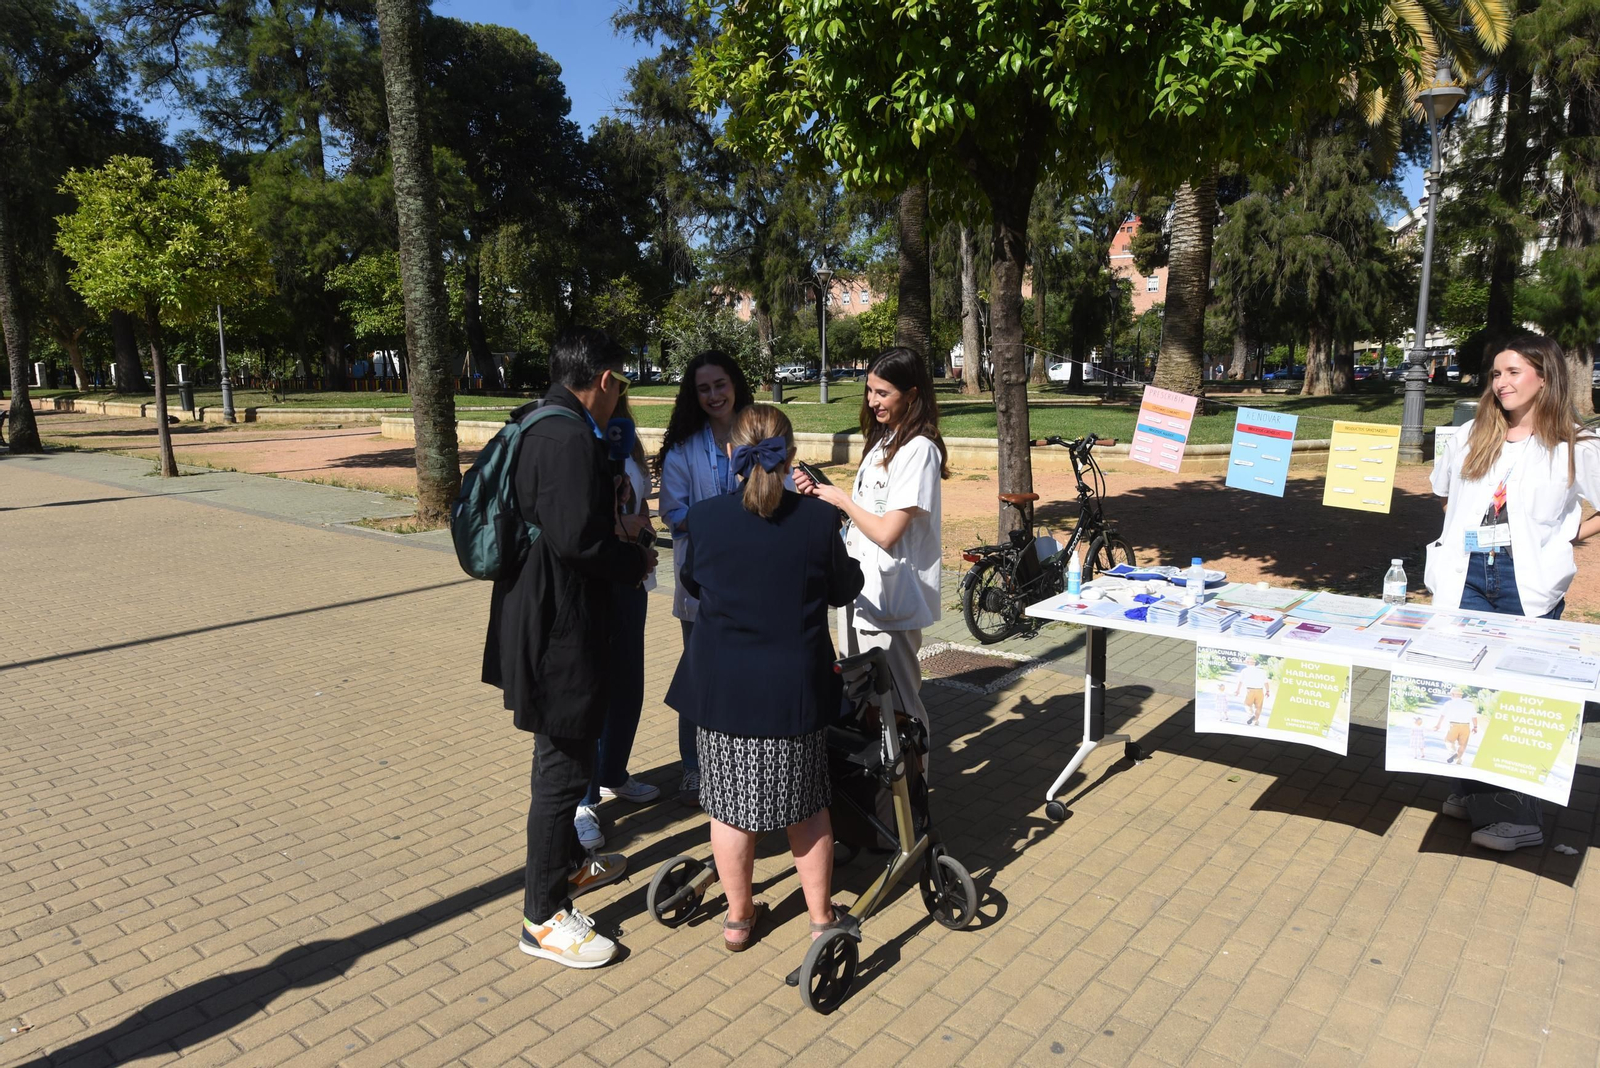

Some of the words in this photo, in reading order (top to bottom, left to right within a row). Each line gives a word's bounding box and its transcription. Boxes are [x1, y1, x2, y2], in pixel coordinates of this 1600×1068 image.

[1149, 388, 1186, 404] PRESCRIBIR
[1246, 411, 1282, 424] RENOVAR
[1209, 648, 1237, 656] VACUNAS
[1300, 661, 1321, 671] HOY
[1285, 669, 1336, 682] HABLAMOS
[1405, 677, 1440, 687] VACUNAS
[1282, 677, 1294, 685] DE
[1295, 679, 1339, 692] VACUNAS
[1298, 688, 1322, 698] PARA
[1289, 696, 1331, 709] ADULTOS
[1519, 695, 1545, 707] HOY
[1499, 702, 1563, 720] HABLAMOS
[1494, 711, 1509, 721] DE
[1511, 715, 1566, 732] VACUNAS
[1513, 725, 1544, 738] PARA
[1501, 733, 1553, 750] ADULTOS
